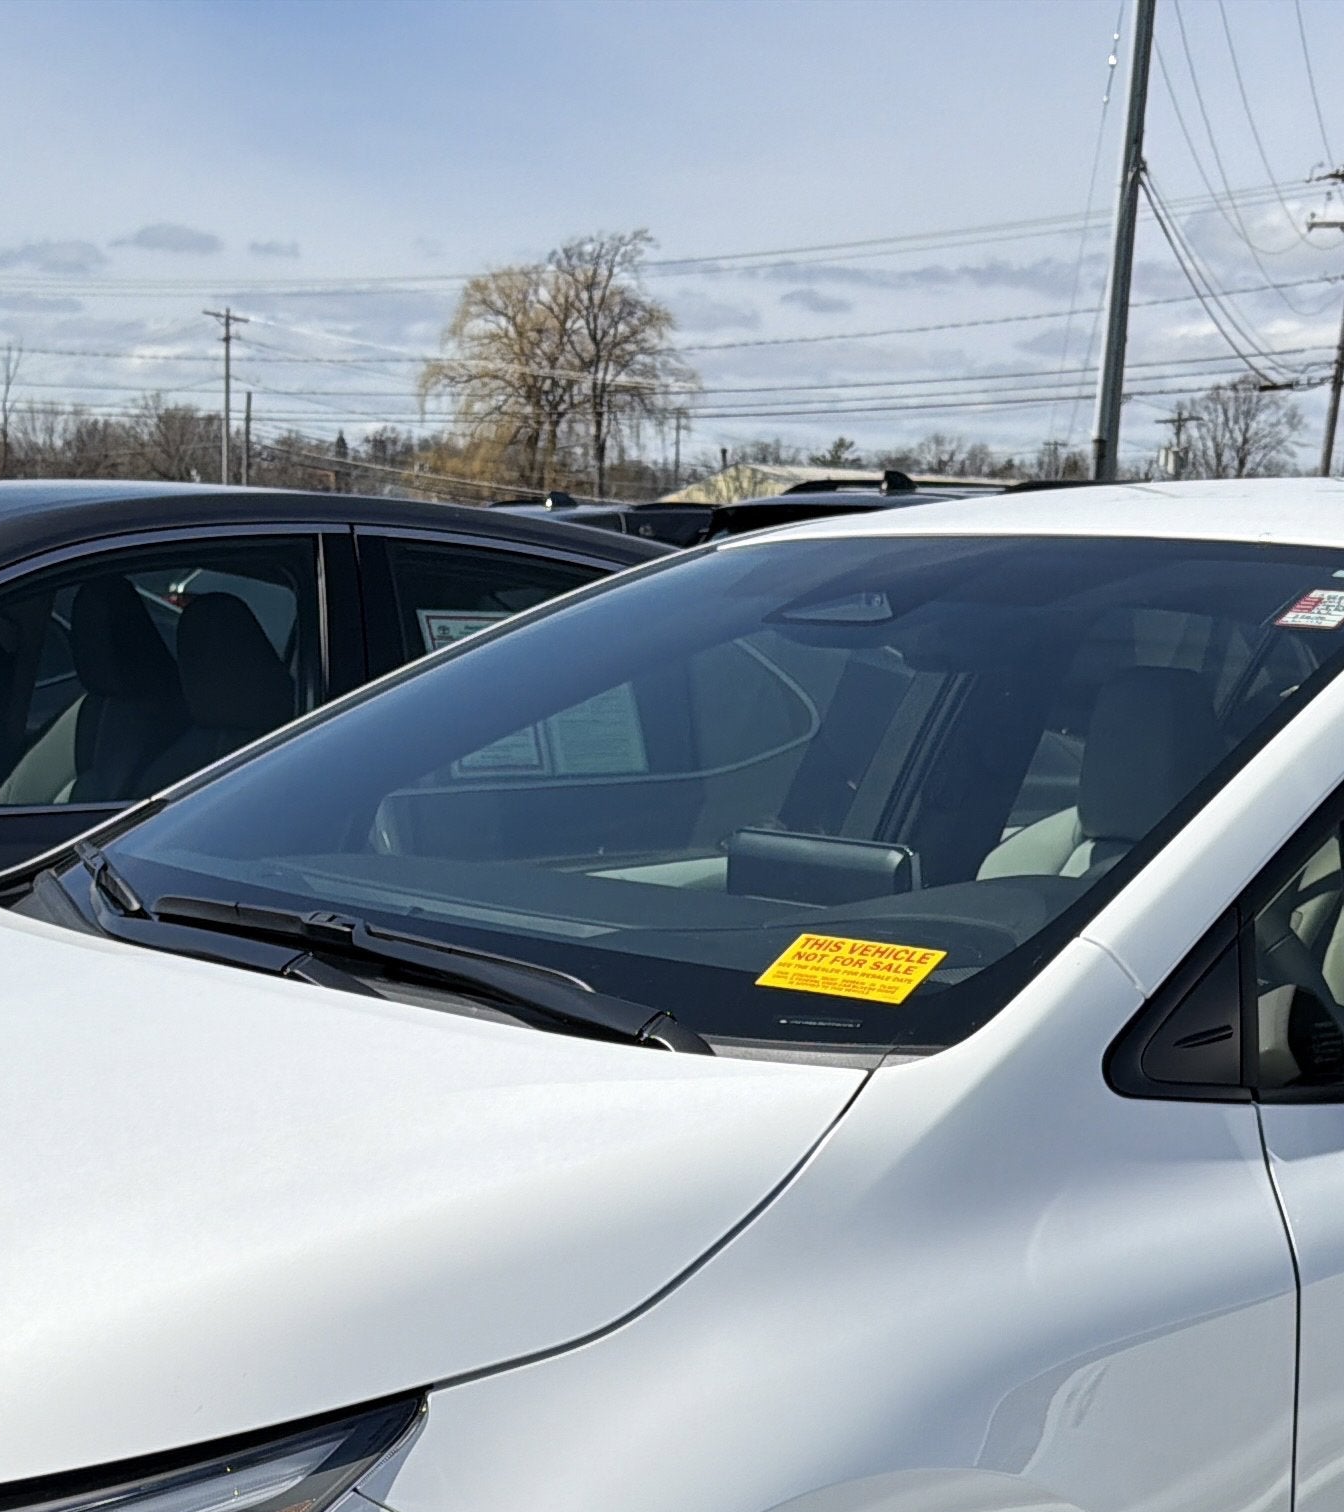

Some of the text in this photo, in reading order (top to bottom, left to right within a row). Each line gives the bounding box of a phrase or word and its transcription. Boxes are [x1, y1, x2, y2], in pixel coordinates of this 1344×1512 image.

[791, 951, 918, 976] NOT FOR SALE
[800, 937, 936, 965] THIS VEHICLE
